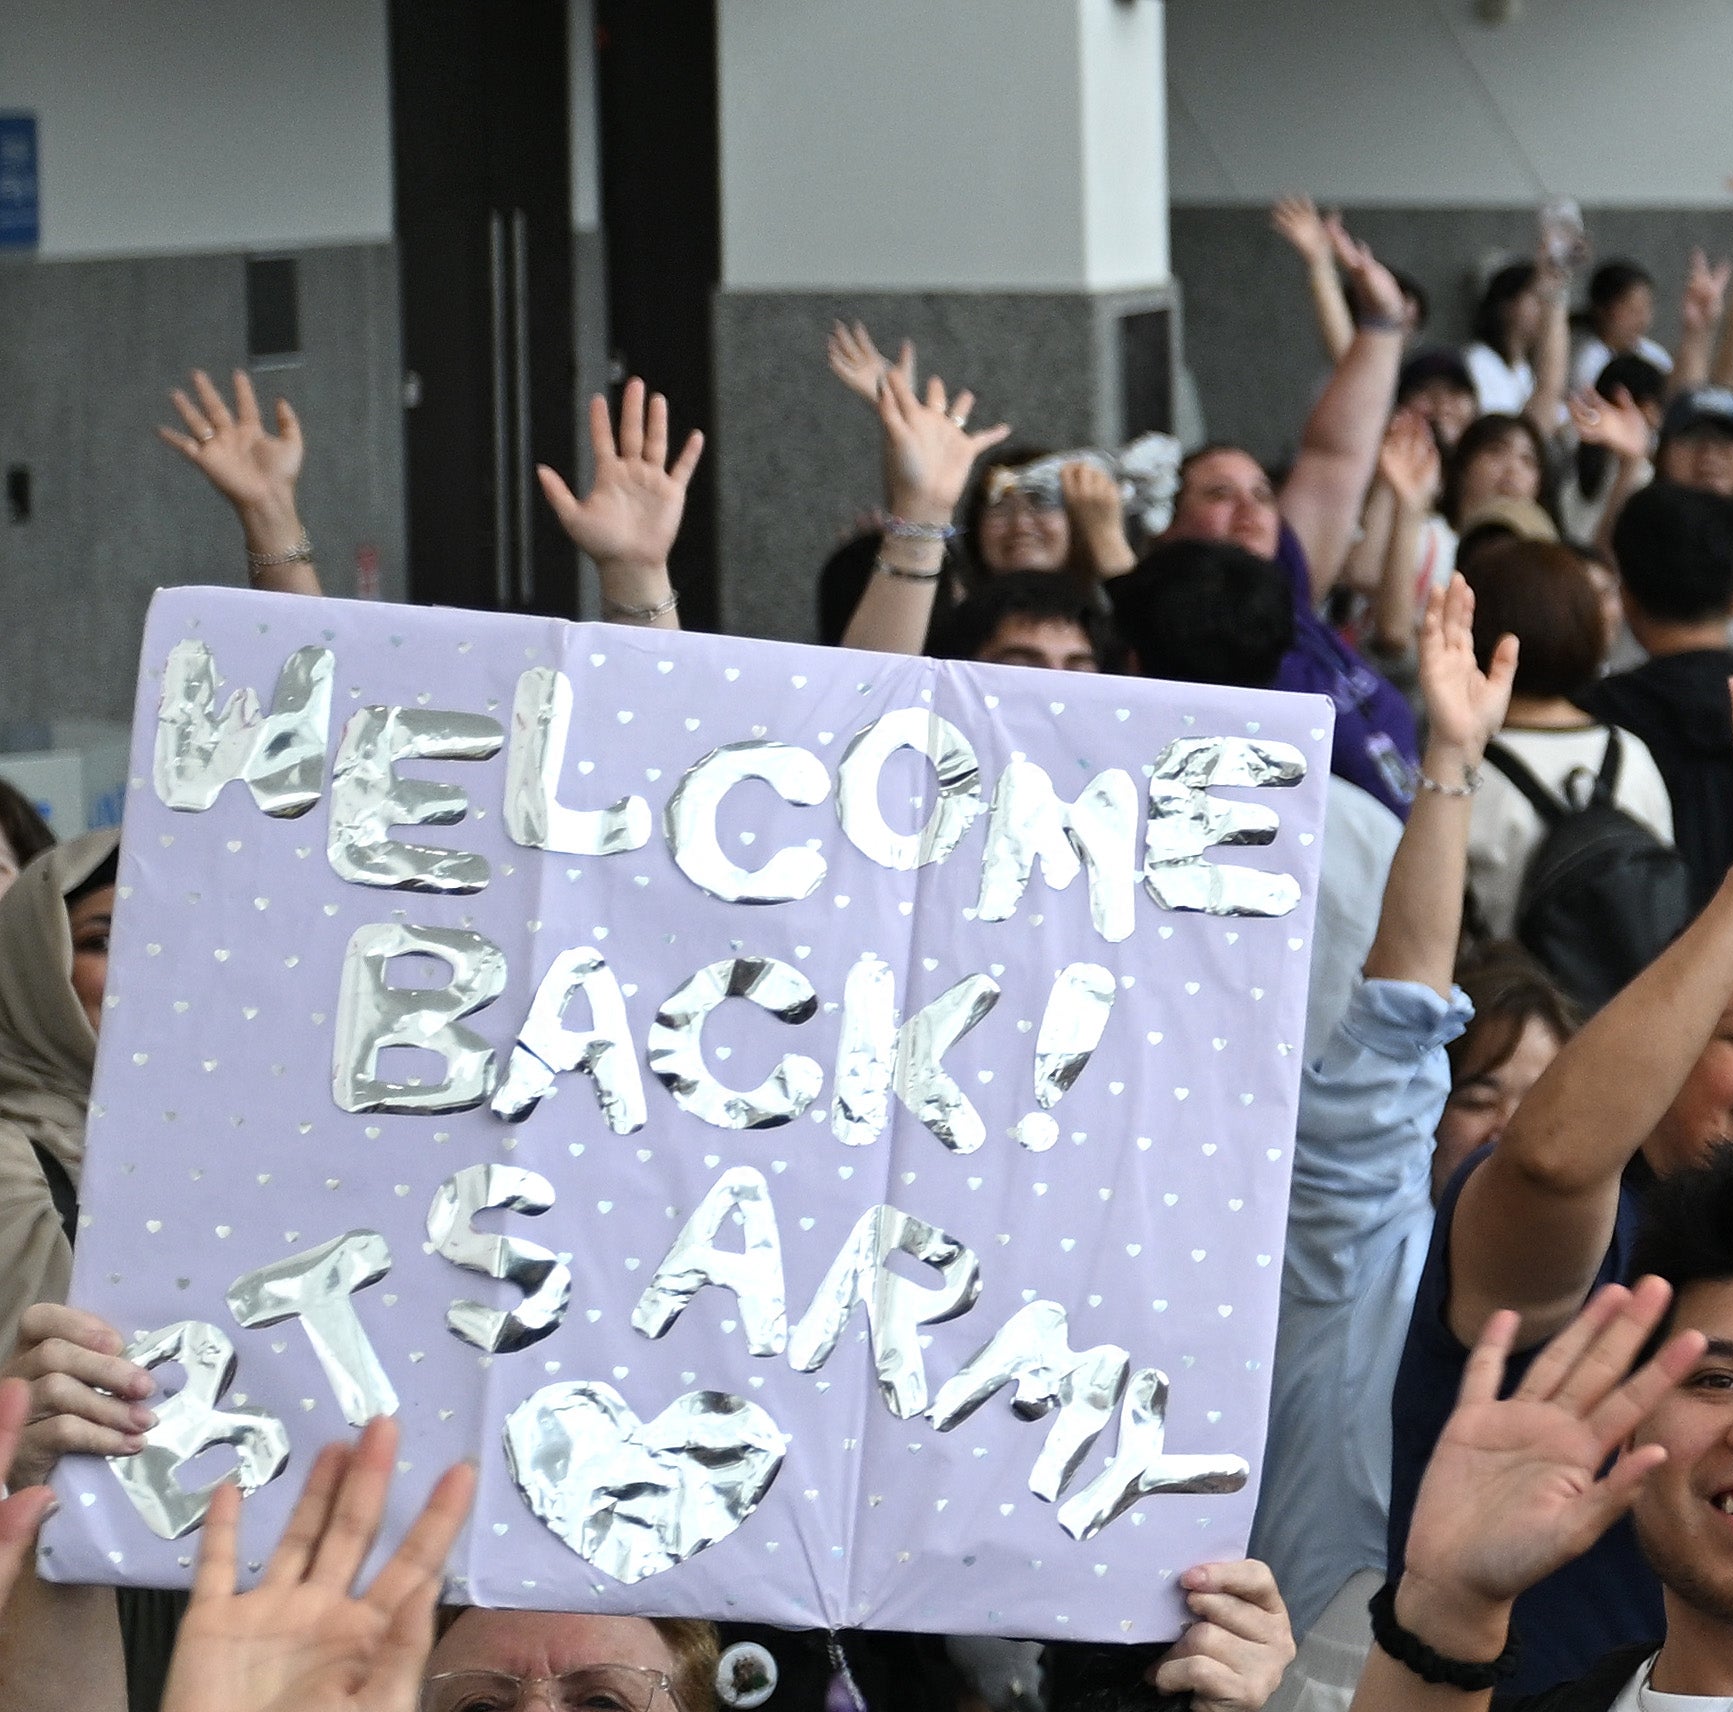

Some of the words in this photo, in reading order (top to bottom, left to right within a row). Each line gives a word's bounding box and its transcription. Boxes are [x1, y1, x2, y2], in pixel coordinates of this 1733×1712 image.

[154, 639, 1307, 941] WELCOME
[332, 923, 1116, 1154] BACK!
[109, 1162, 571, 1539] BTS
[631, 1165, 1249, 1539] ARMY
